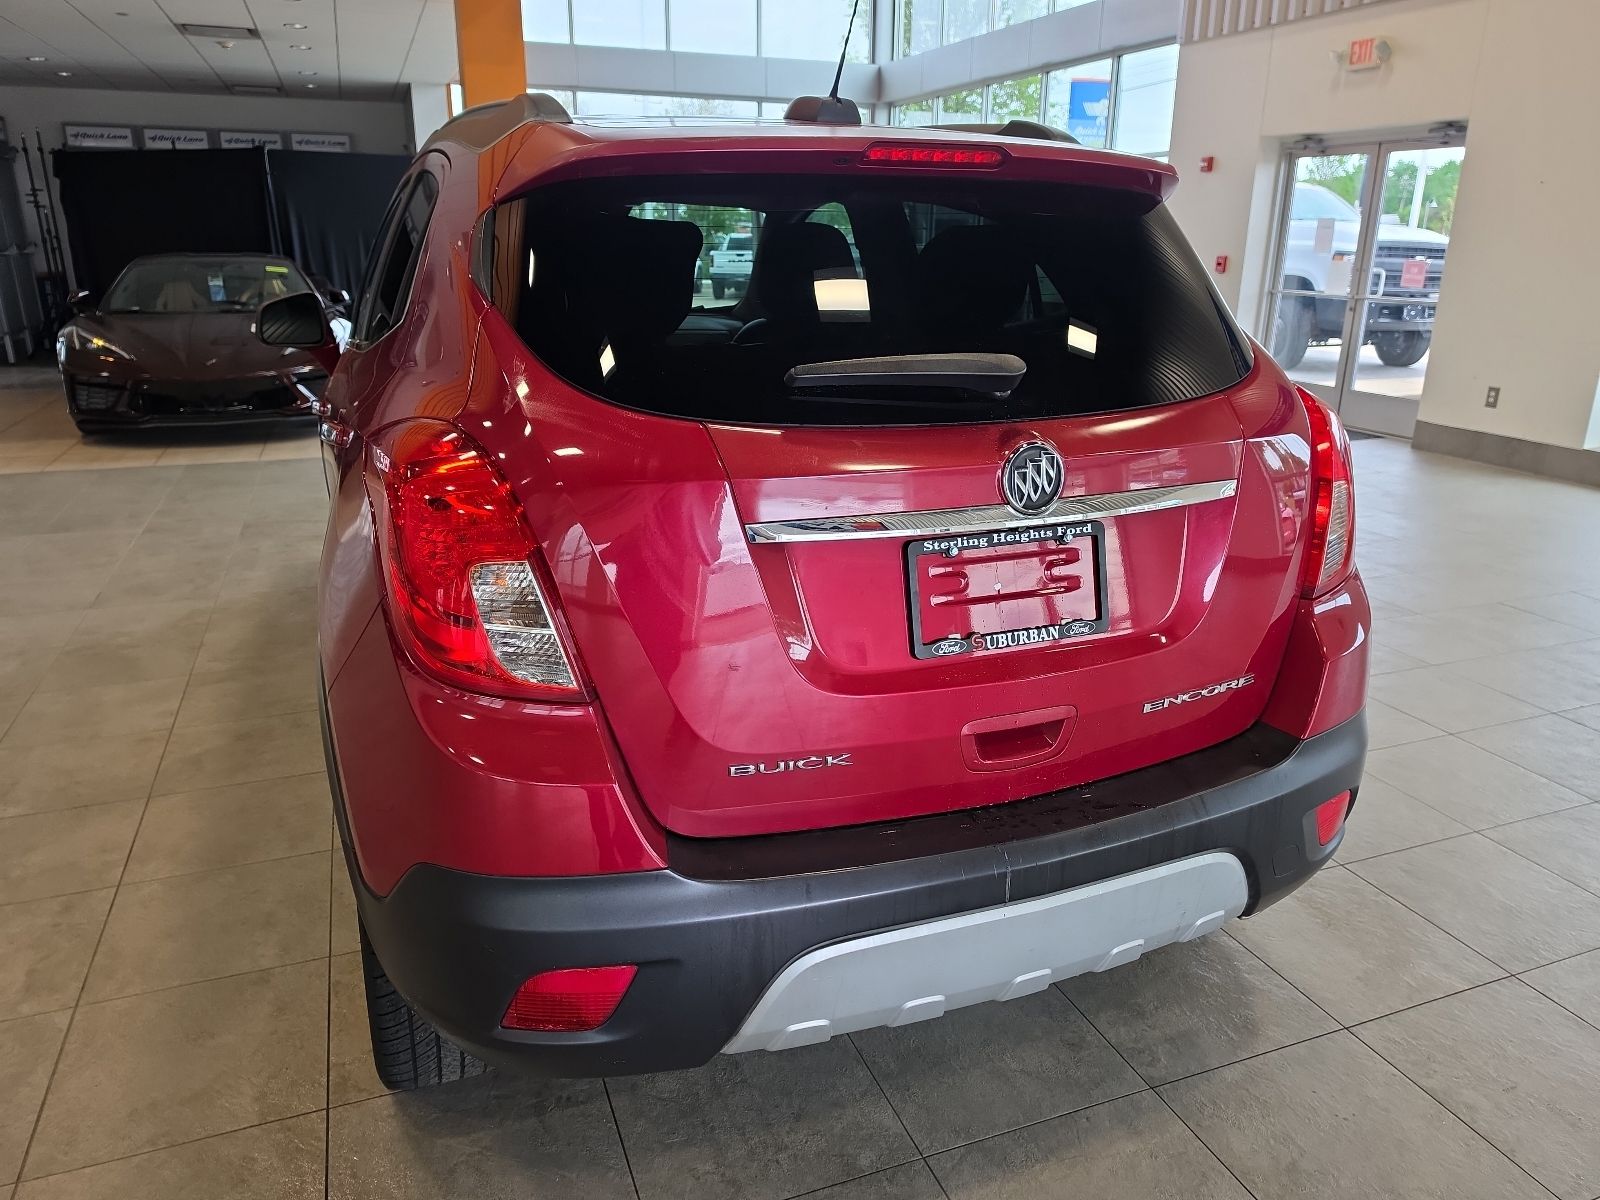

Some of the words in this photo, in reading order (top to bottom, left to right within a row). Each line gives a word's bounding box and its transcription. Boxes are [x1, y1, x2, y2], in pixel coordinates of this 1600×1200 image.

[1349, 38, 1376, 65] EXIT
[923, 537, 989, 552] Sterling
[992, 528, 1053, 543] Heights
[1056, 523, 1093, 537] Ford
[938, 640, 961, 654] Ford
[971, 625, 1060, 652] SUBURBAN
[1069, 622, 1090, 635] Ford
[1142, 673, 1255, 714] ENCORE
[728, 752, 854, 777] BUICK
